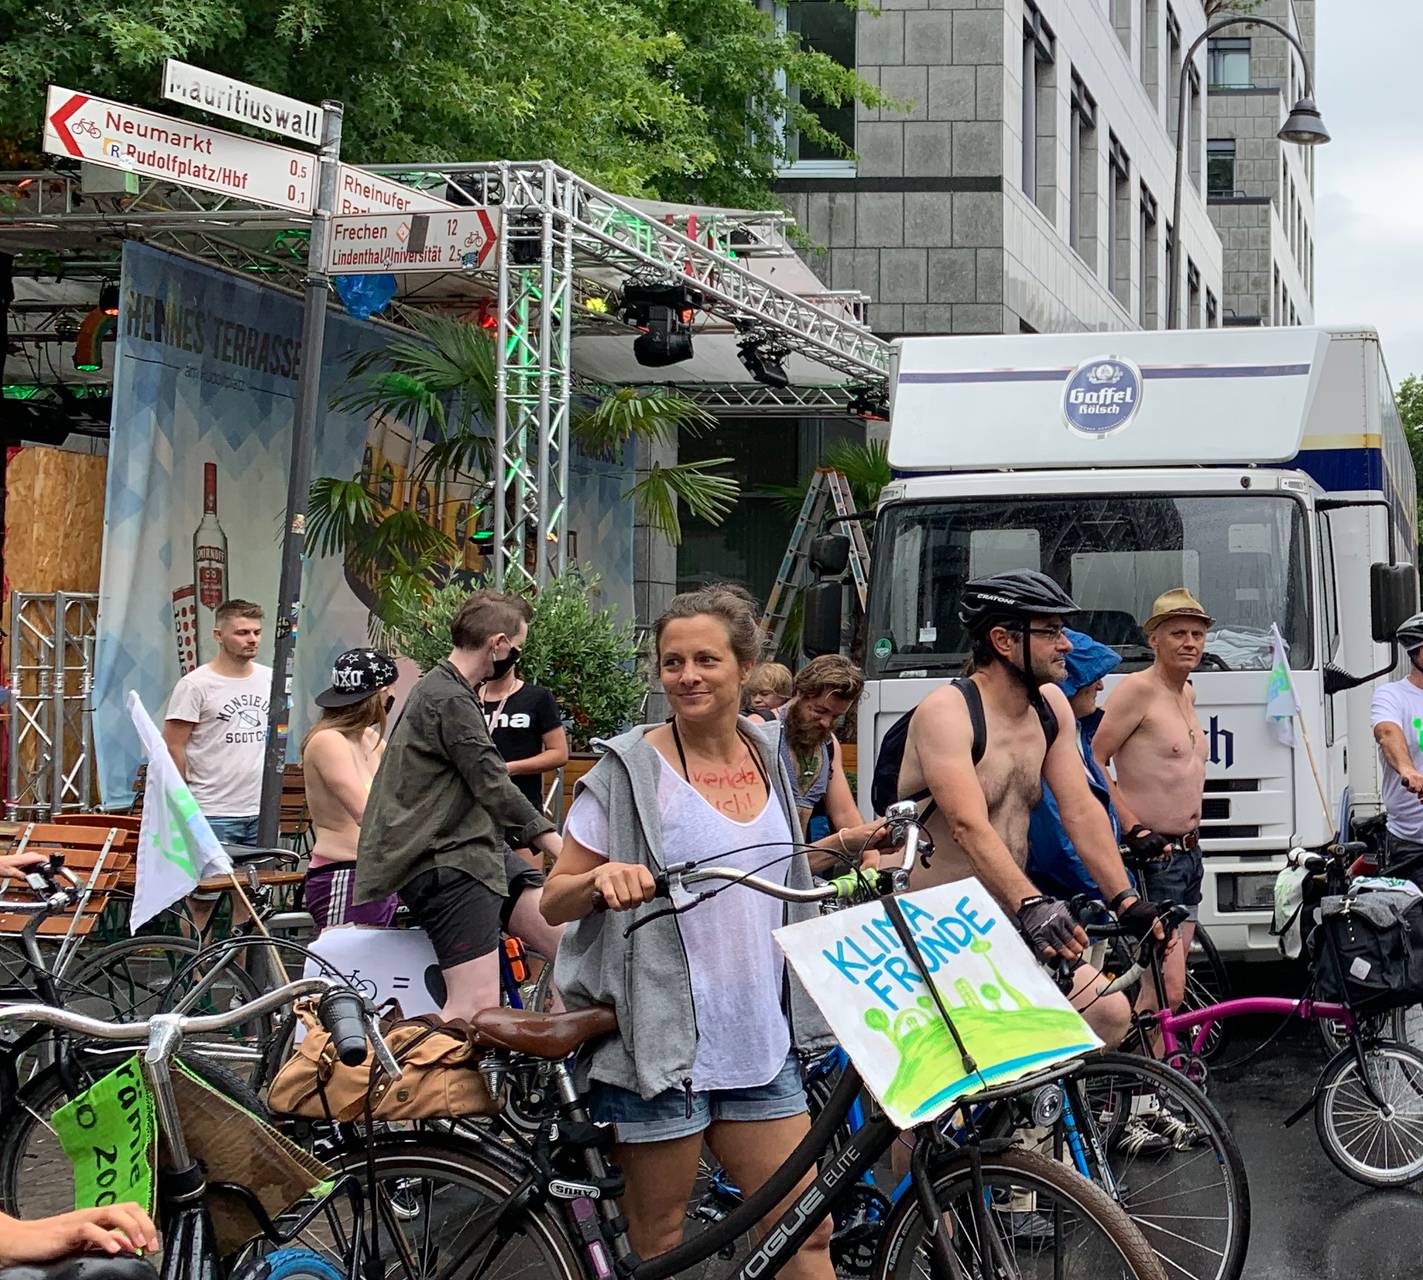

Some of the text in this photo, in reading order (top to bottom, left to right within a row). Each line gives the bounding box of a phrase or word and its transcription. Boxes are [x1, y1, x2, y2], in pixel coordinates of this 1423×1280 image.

[105, 111, 213, 154] Neumarkt
[126, 143, 249, 189] Rudolfplatz/Hbf
[344, 174, 411, 212] Rheinufer
[334, 219, 458, 241] Frechen 12
[332, 246, 442, 266] Lindenthal/Universität
[213, 317, 302, 381] TERRASSE
[1069, 387, 1134, 405] Gaffel
[1079, 403, 1120, 415] Kölsch
[196, 547, 225, 562] SMIRNOFF
[977, 593, 1016, 605] CRATONI
[216, 694, 271, 723] MONSIEU
[225, 731, 265, 744] SCOTC
[822, 898, 935, 985] KLIMA
[822, 1145, 861, 1188] ELITE
